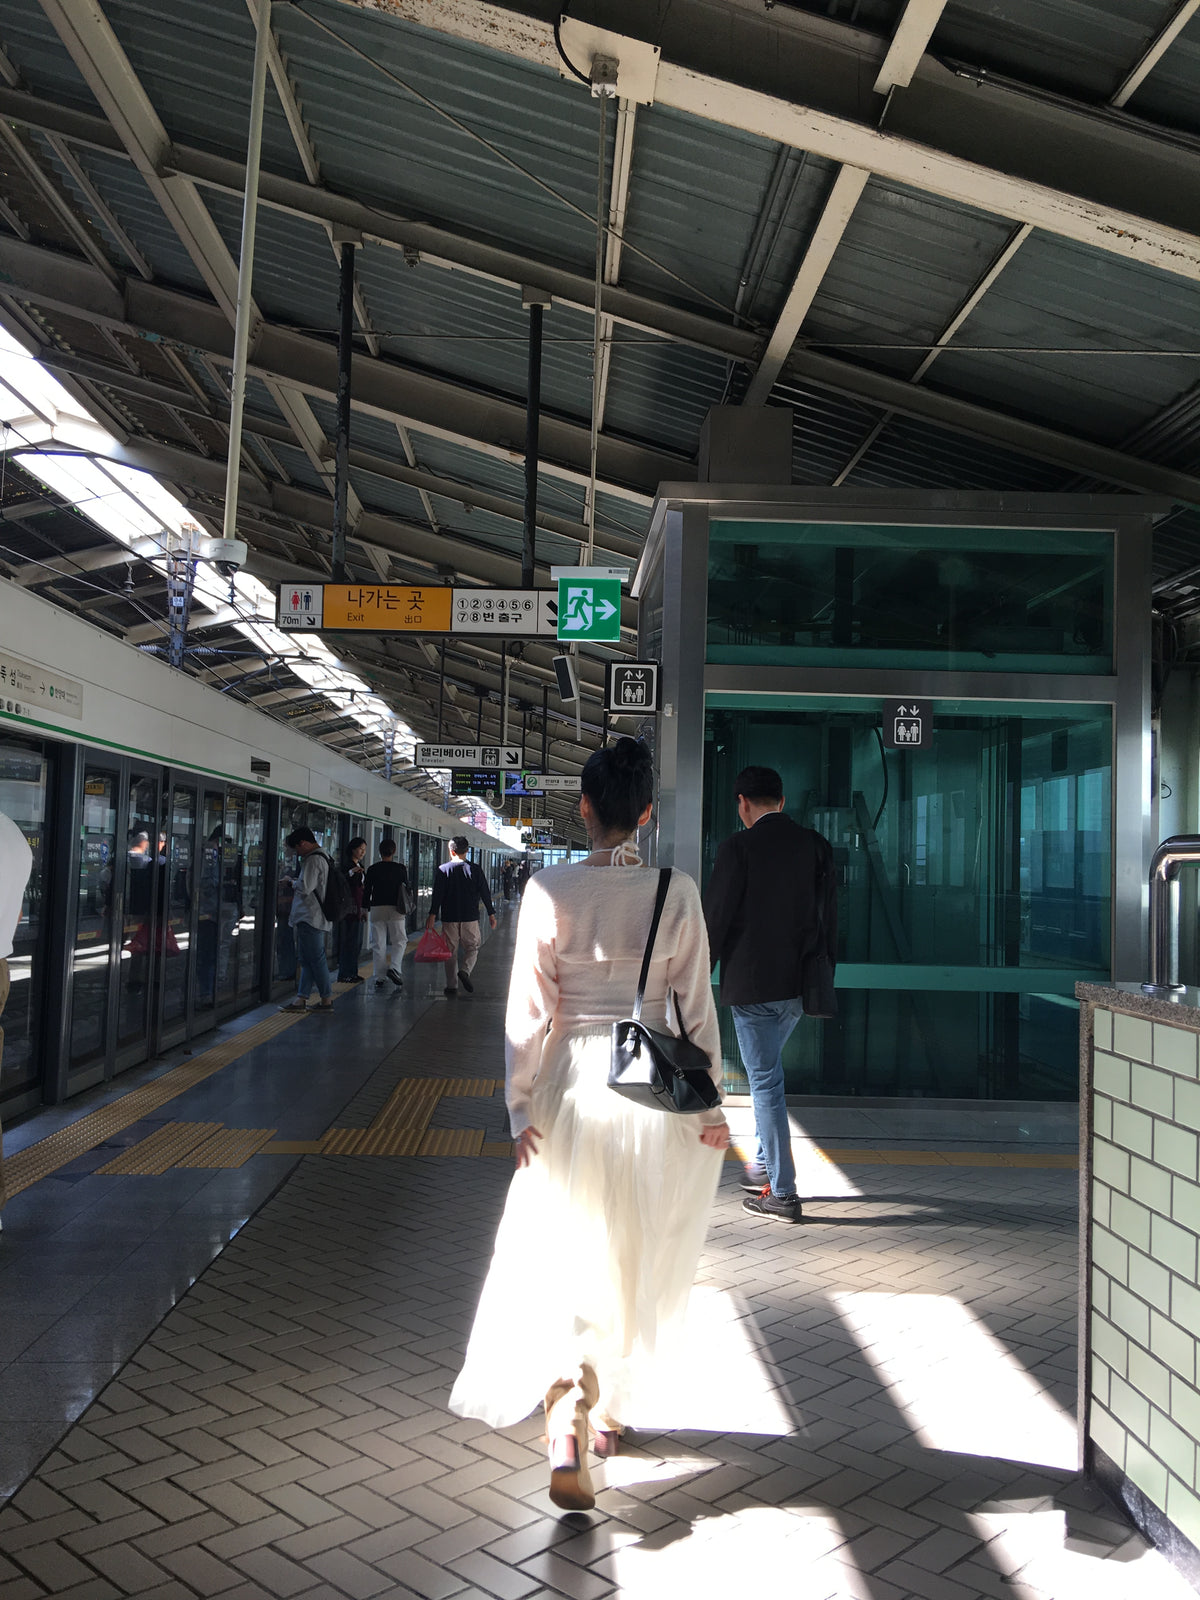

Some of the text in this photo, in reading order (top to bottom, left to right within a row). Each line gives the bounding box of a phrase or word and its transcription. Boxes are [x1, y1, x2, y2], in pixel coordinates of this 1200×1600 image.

[347, 588, 425, 611] 나가는 곳
[282, 615, 300, 625] 70m
[347, 612, 365, 622] Exit
[404, 615, 422, 625] 出口
[499, 613, 523, 624] 출구
[421, 747, 476, 758] 엘리베이터
